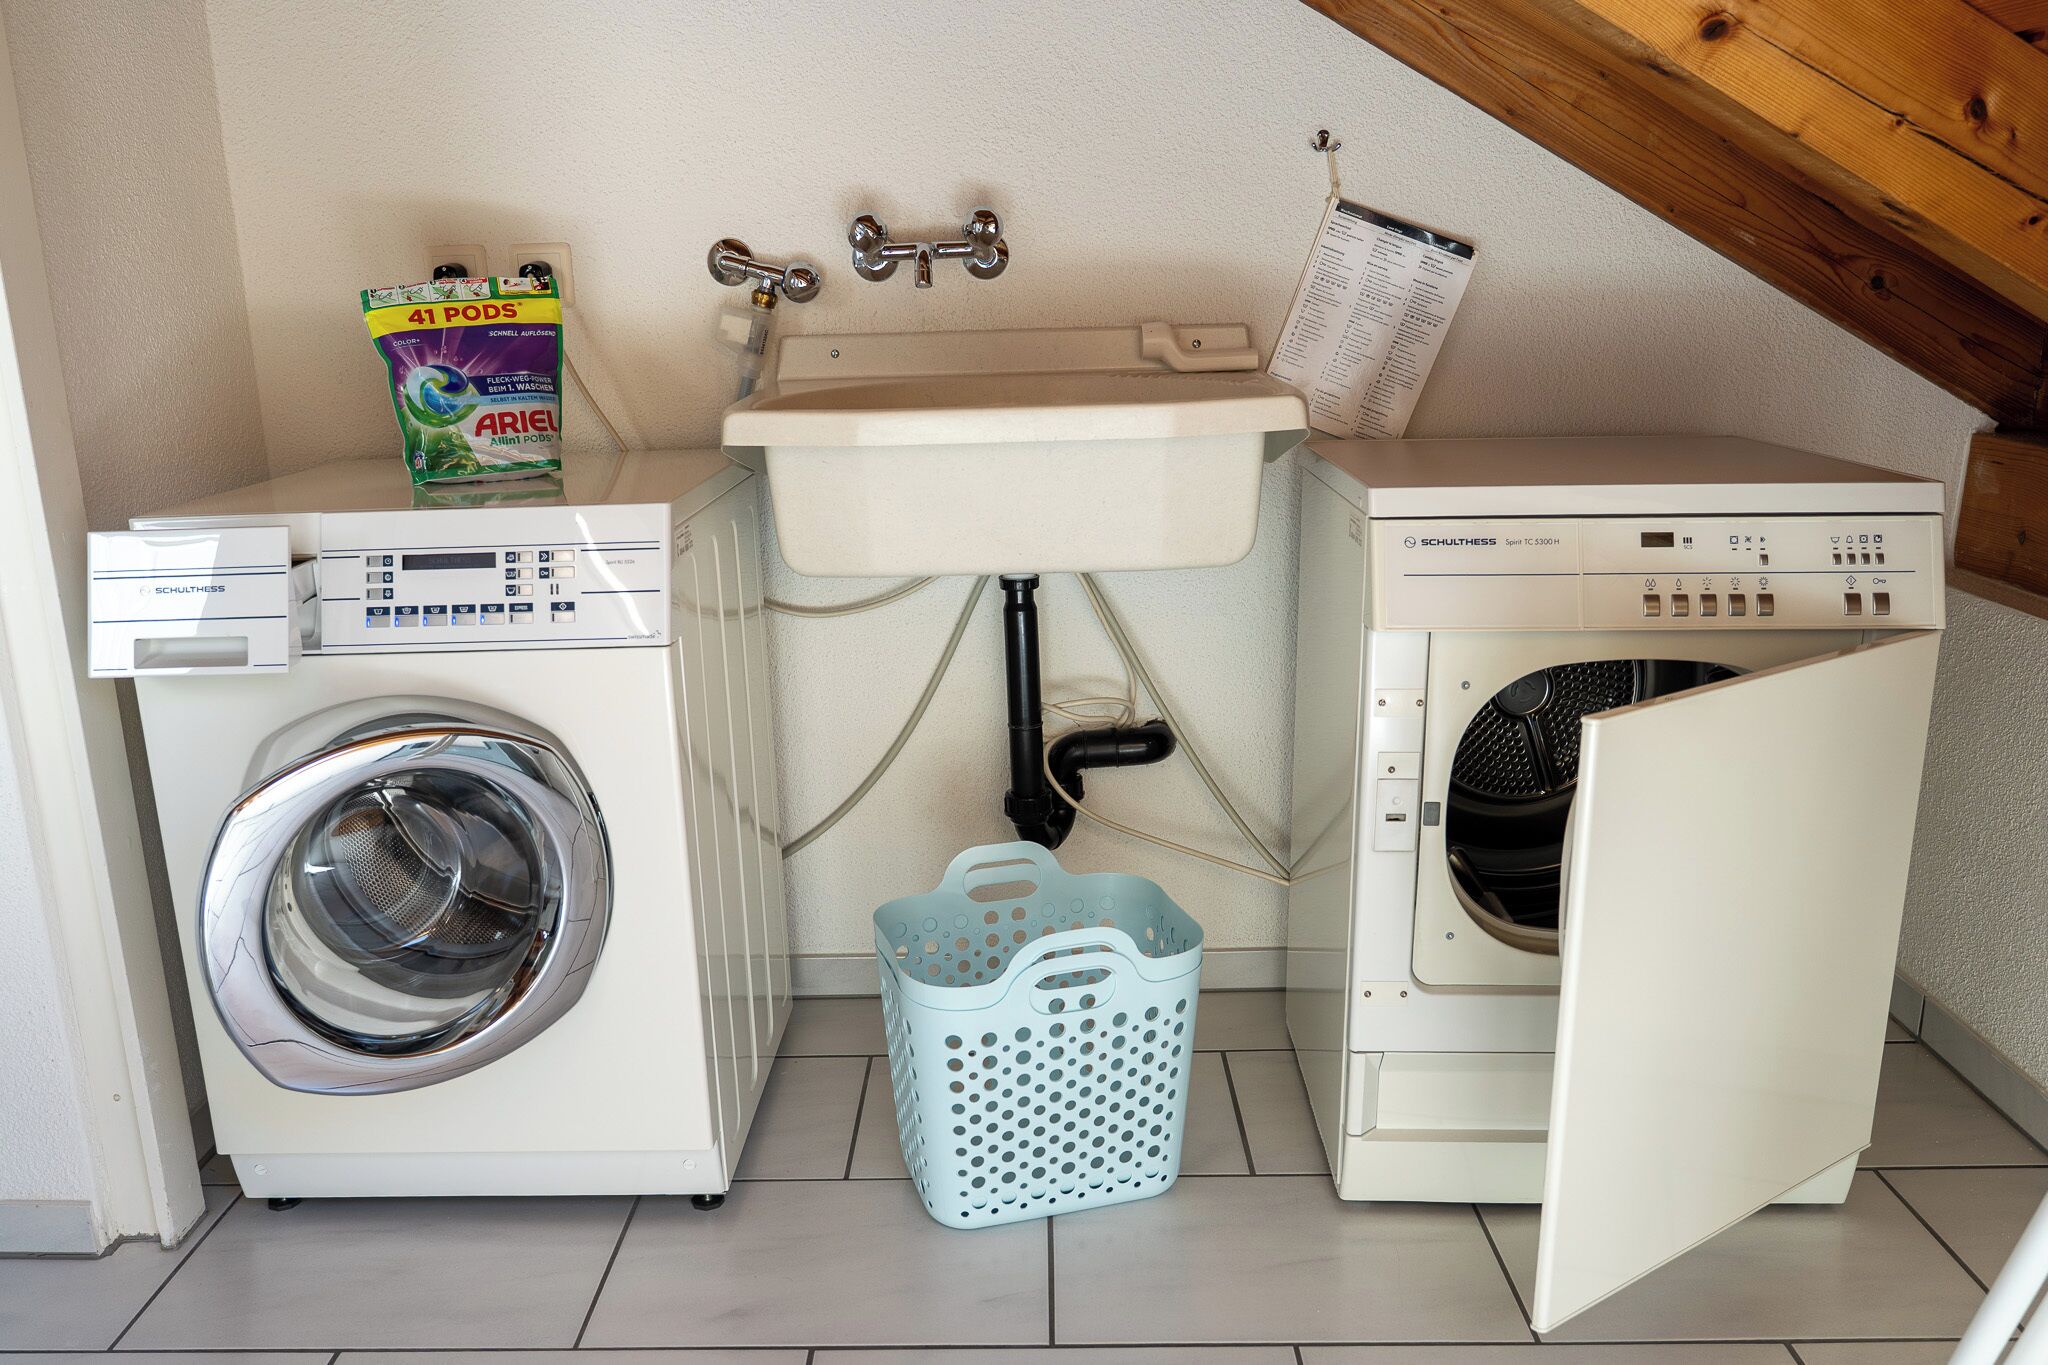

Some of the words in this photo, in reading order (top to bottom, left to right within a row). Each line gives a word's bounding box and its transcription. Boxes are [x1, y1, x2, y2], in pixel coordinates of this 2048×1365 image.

[408, 308, 436, 325] 41
[488, 329, 519, 337] SCHNELL
[393, 338, 420, 347] COLOR+
[487, 375, 552, 384] FLECK-WEG-POWER
[489, 385, 507, 393] BEIM
[515, 383, 554, 391] WASCHEN
[475, 410, 558, 437] ARIEL
[1421, 538, 1497, 546] SCHULTHESS
[1505, 538, 1522, 547] Spirit
[1524, 538, 1533, 546] TC
[155, 585, 226, 594] SCHULTHESS
